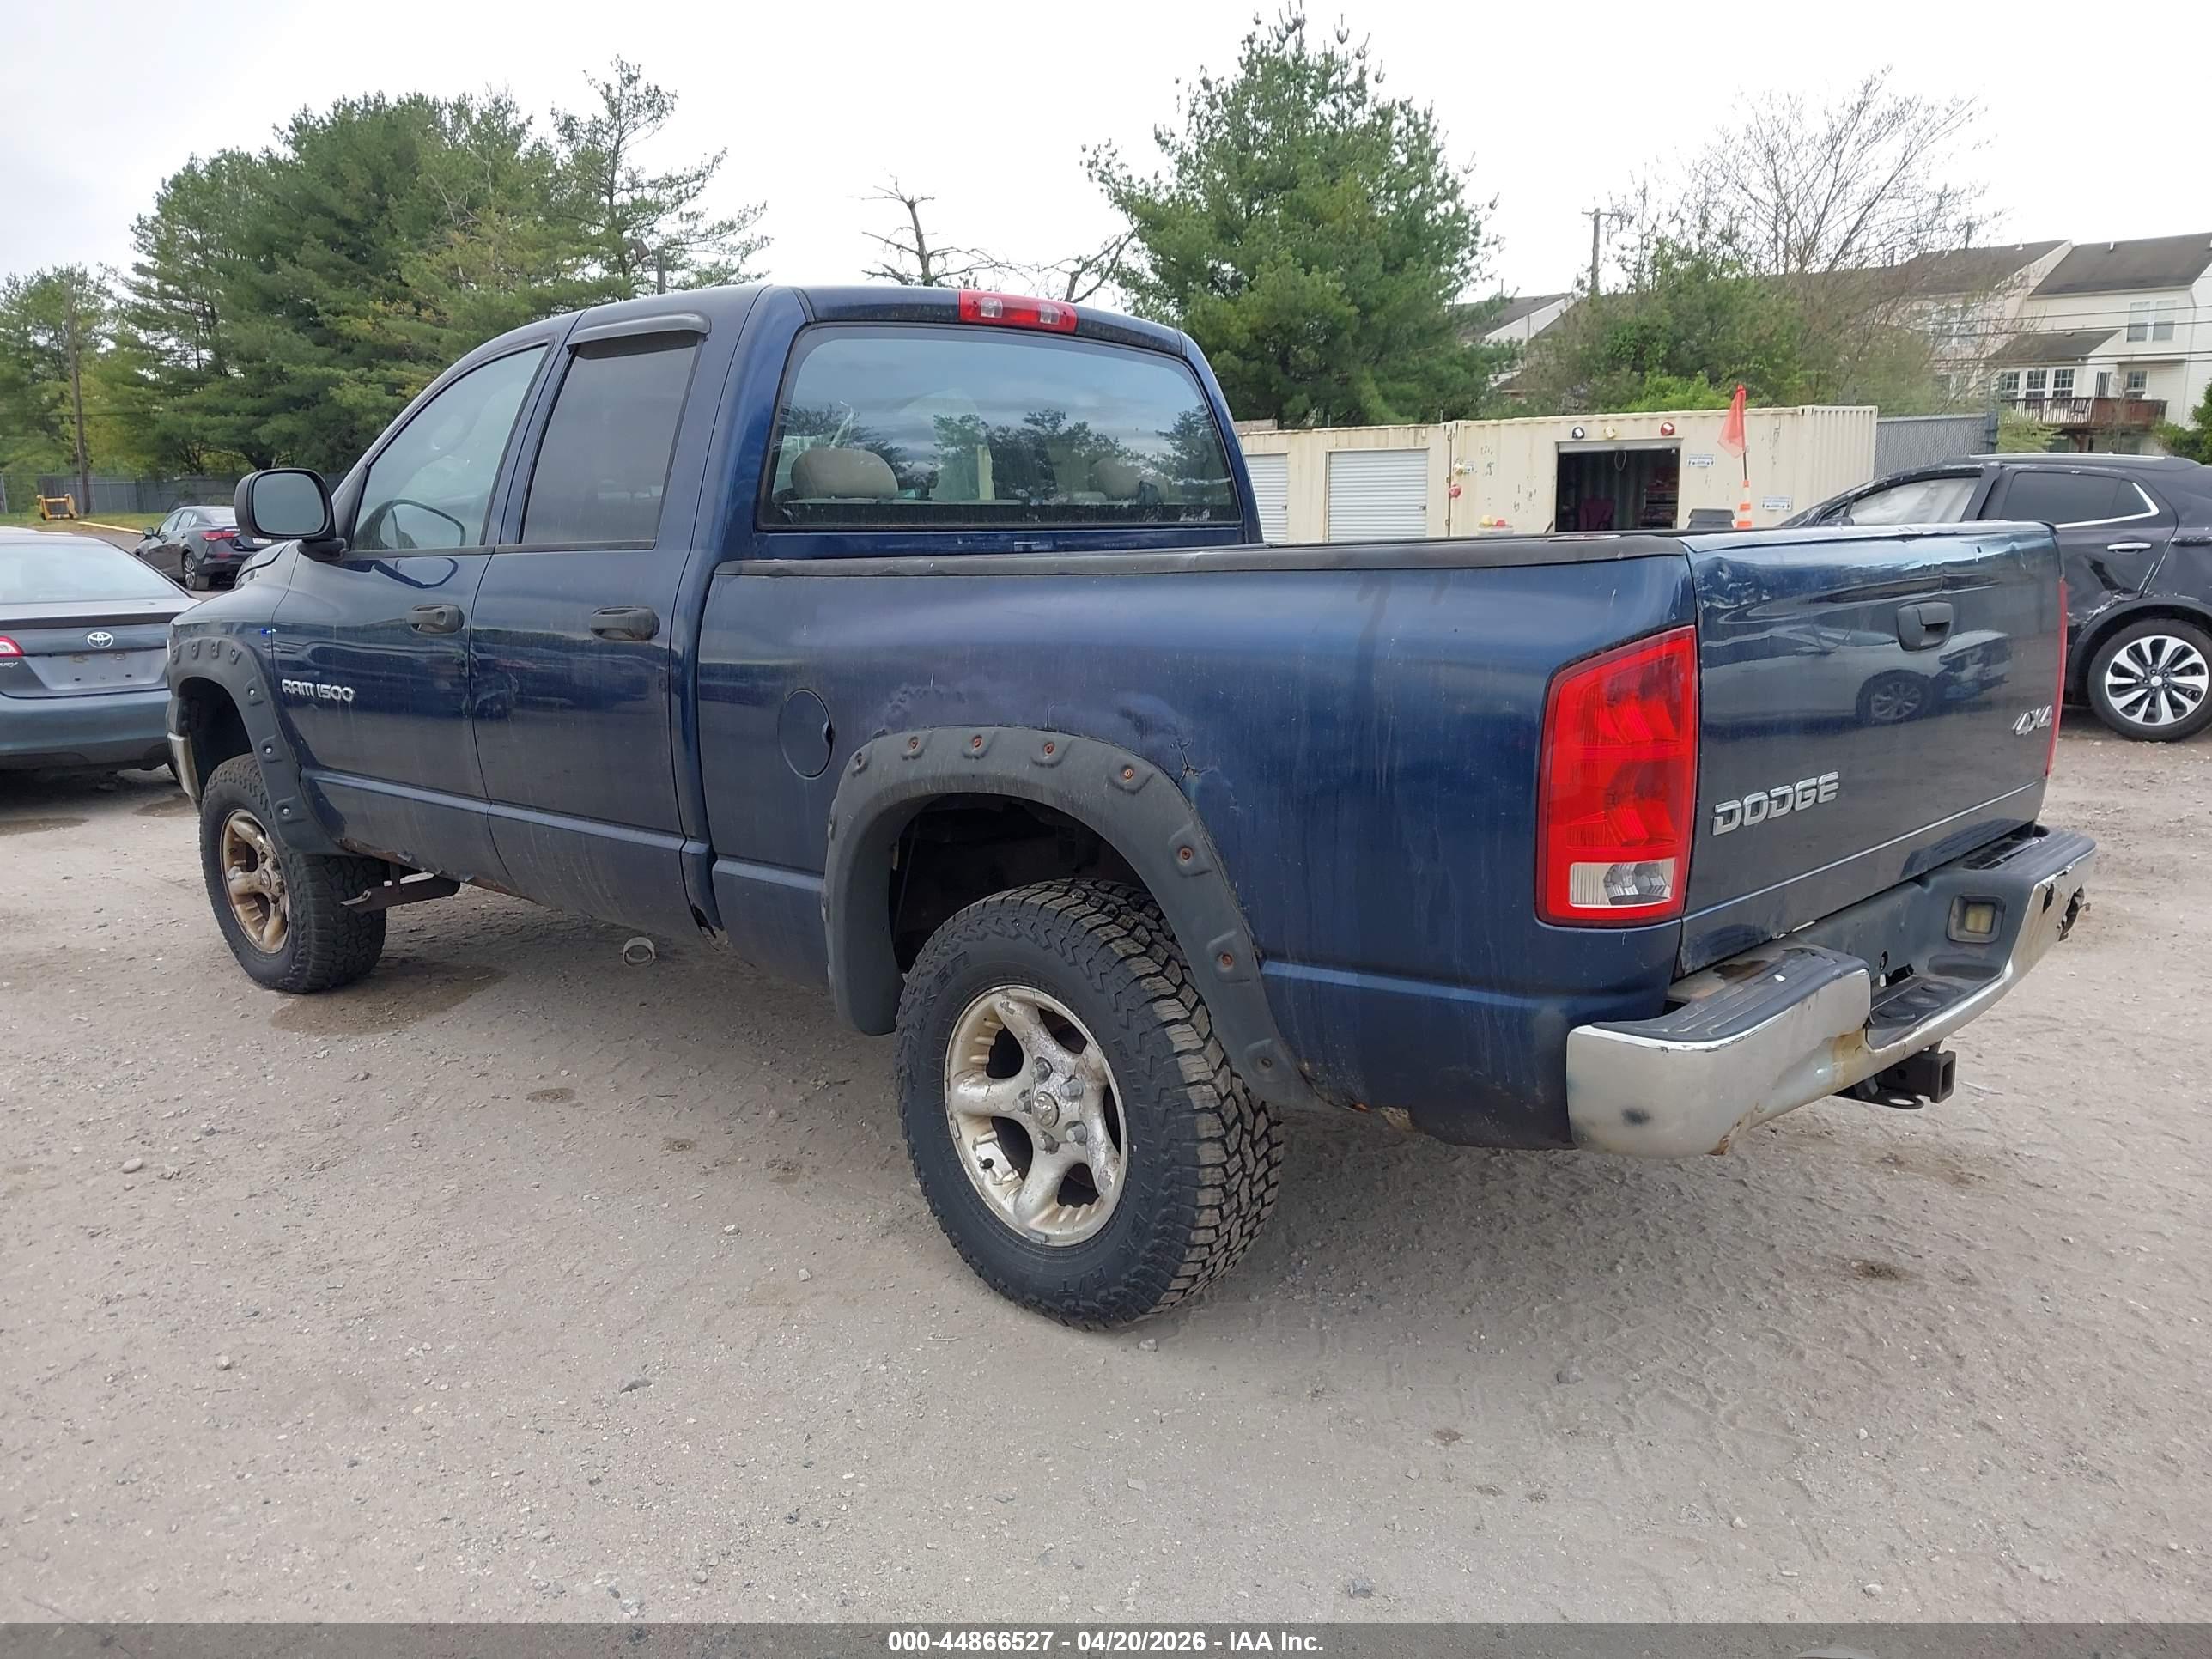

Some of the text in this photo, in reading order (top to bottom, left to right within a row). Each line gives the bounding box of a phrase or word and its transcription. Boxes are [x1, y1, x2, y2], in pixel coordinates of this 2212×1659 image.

[281, 678, 356, 702] RAM 1500
[1712, 771, 1839, 836] DODGE
